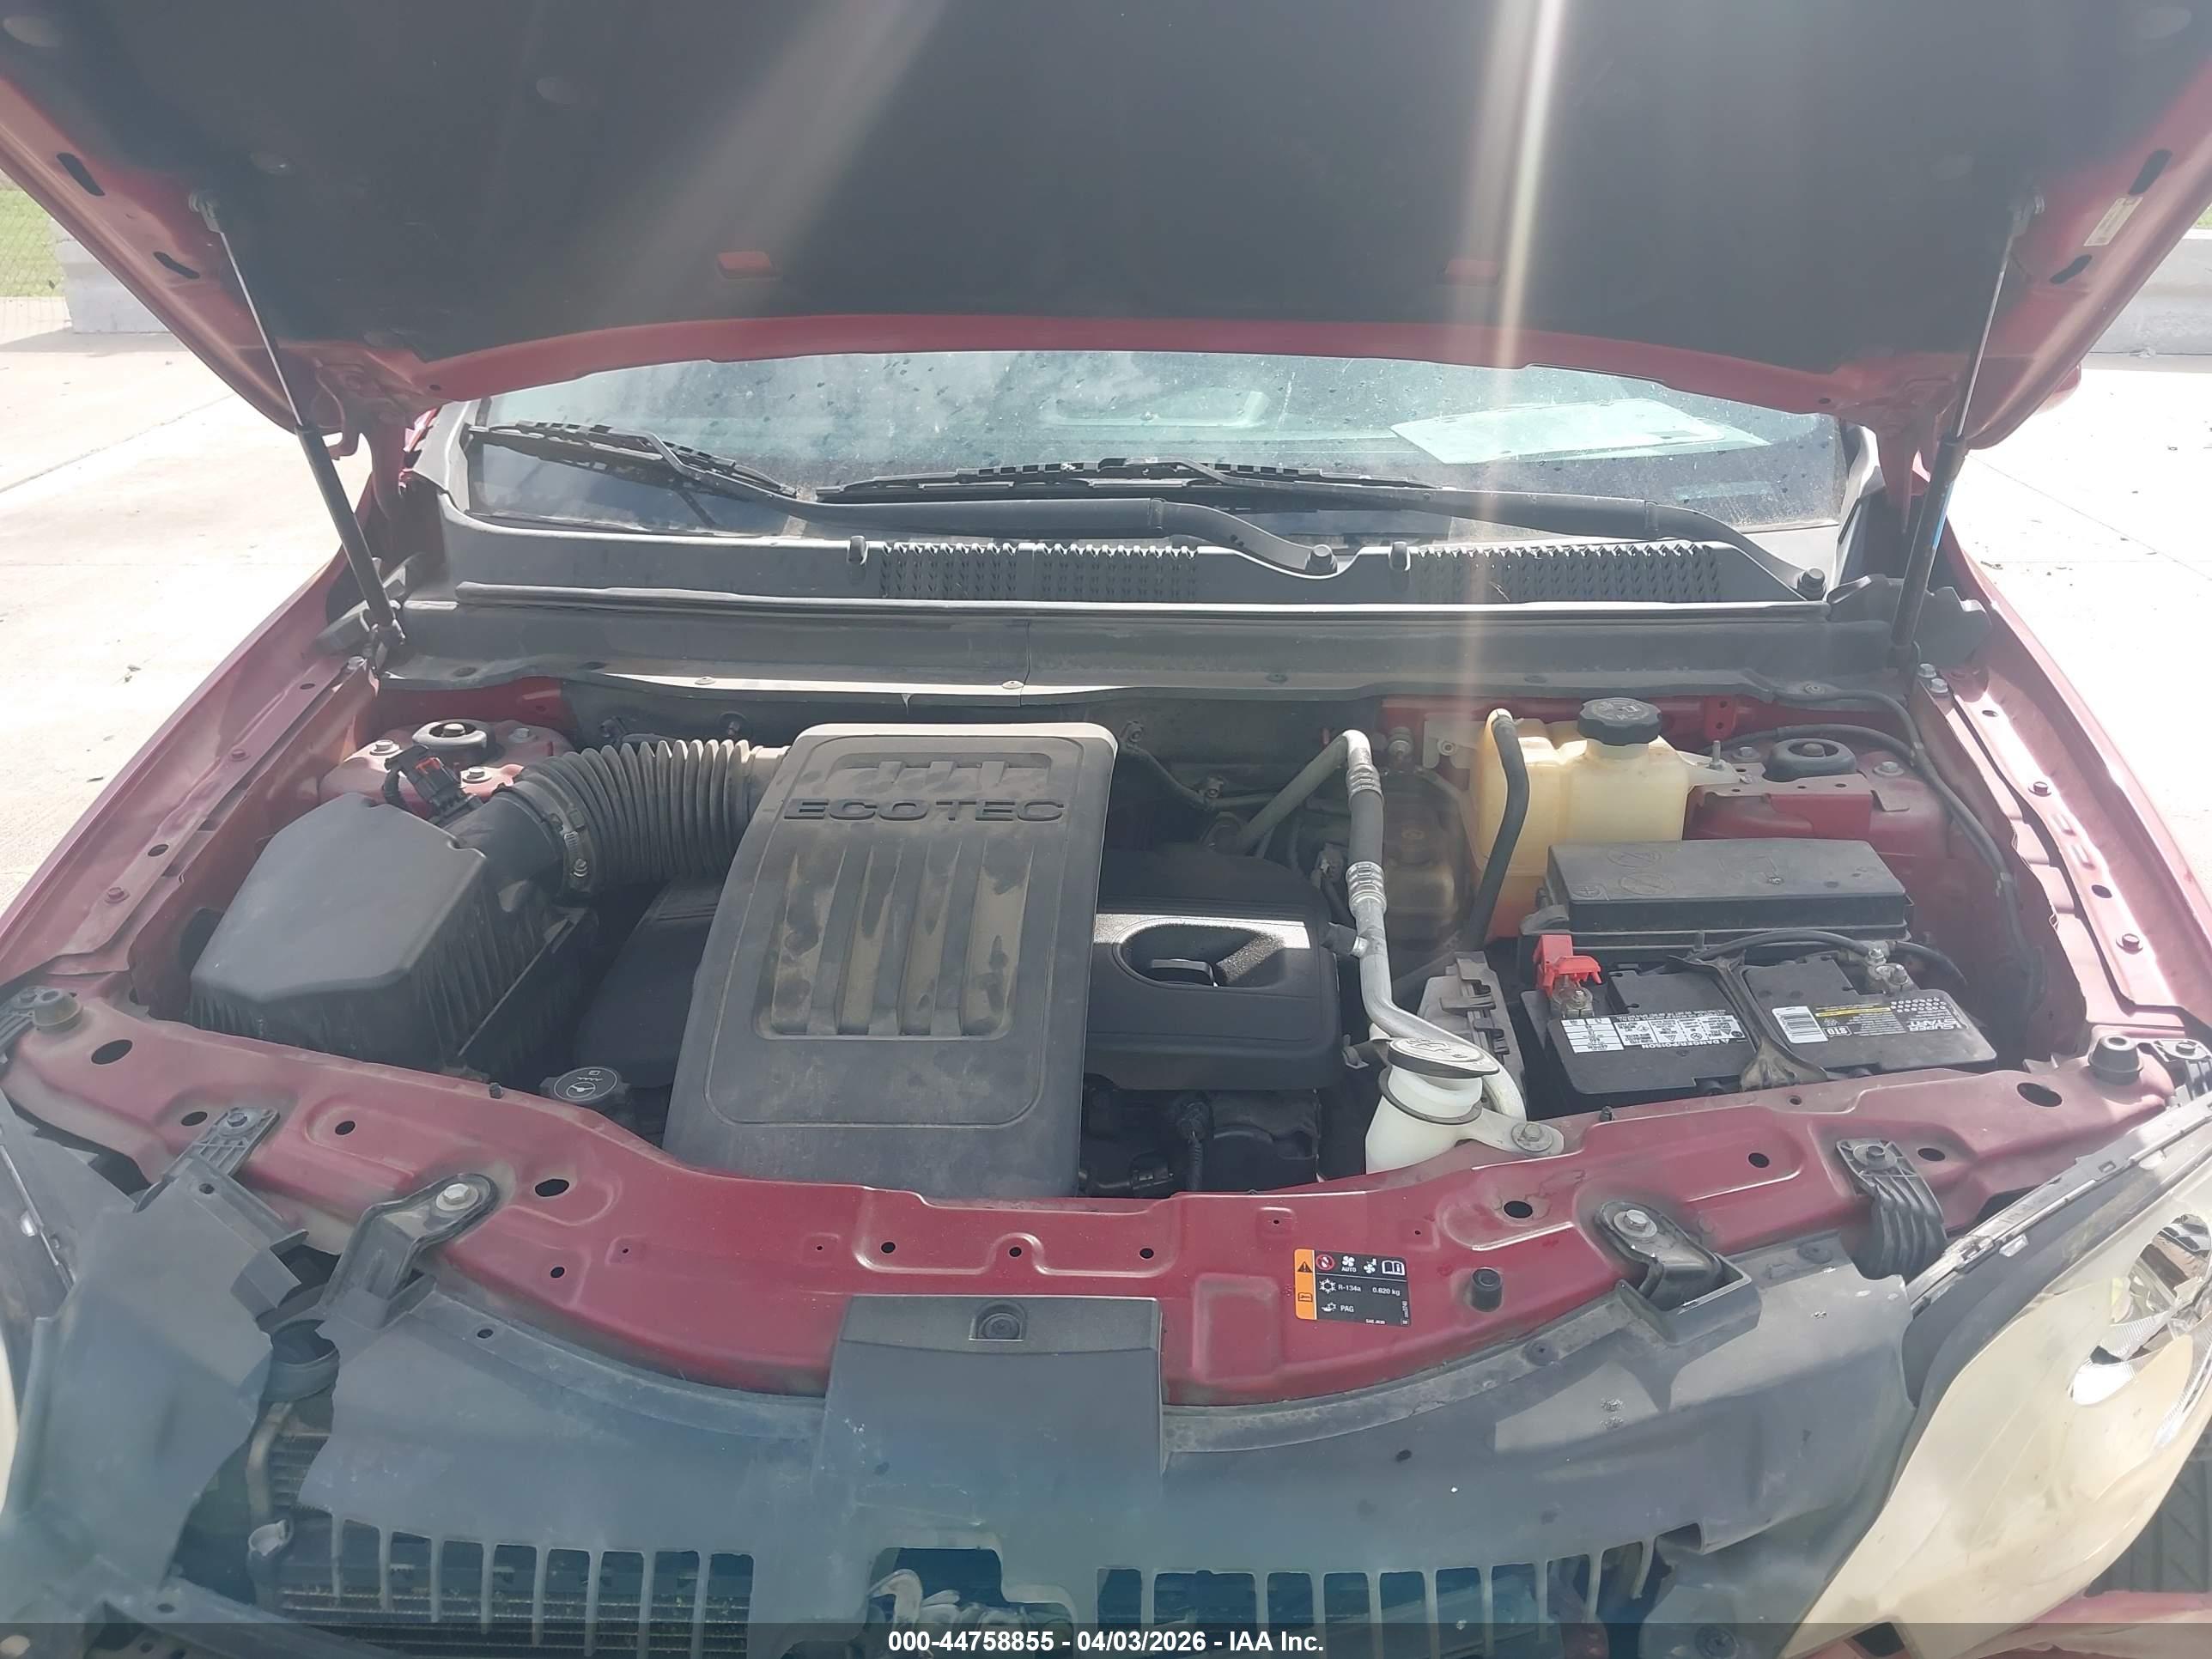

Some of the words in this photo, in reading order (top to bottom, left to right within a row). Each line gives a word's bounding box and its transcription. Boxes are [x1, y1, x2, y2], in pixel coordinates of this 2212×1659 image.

[784, 798, 1066, 822] ECOTEC
[1338, 1284, 1362, 1292] R-134a
[1340, 1304, 1354, 1313] PAG
